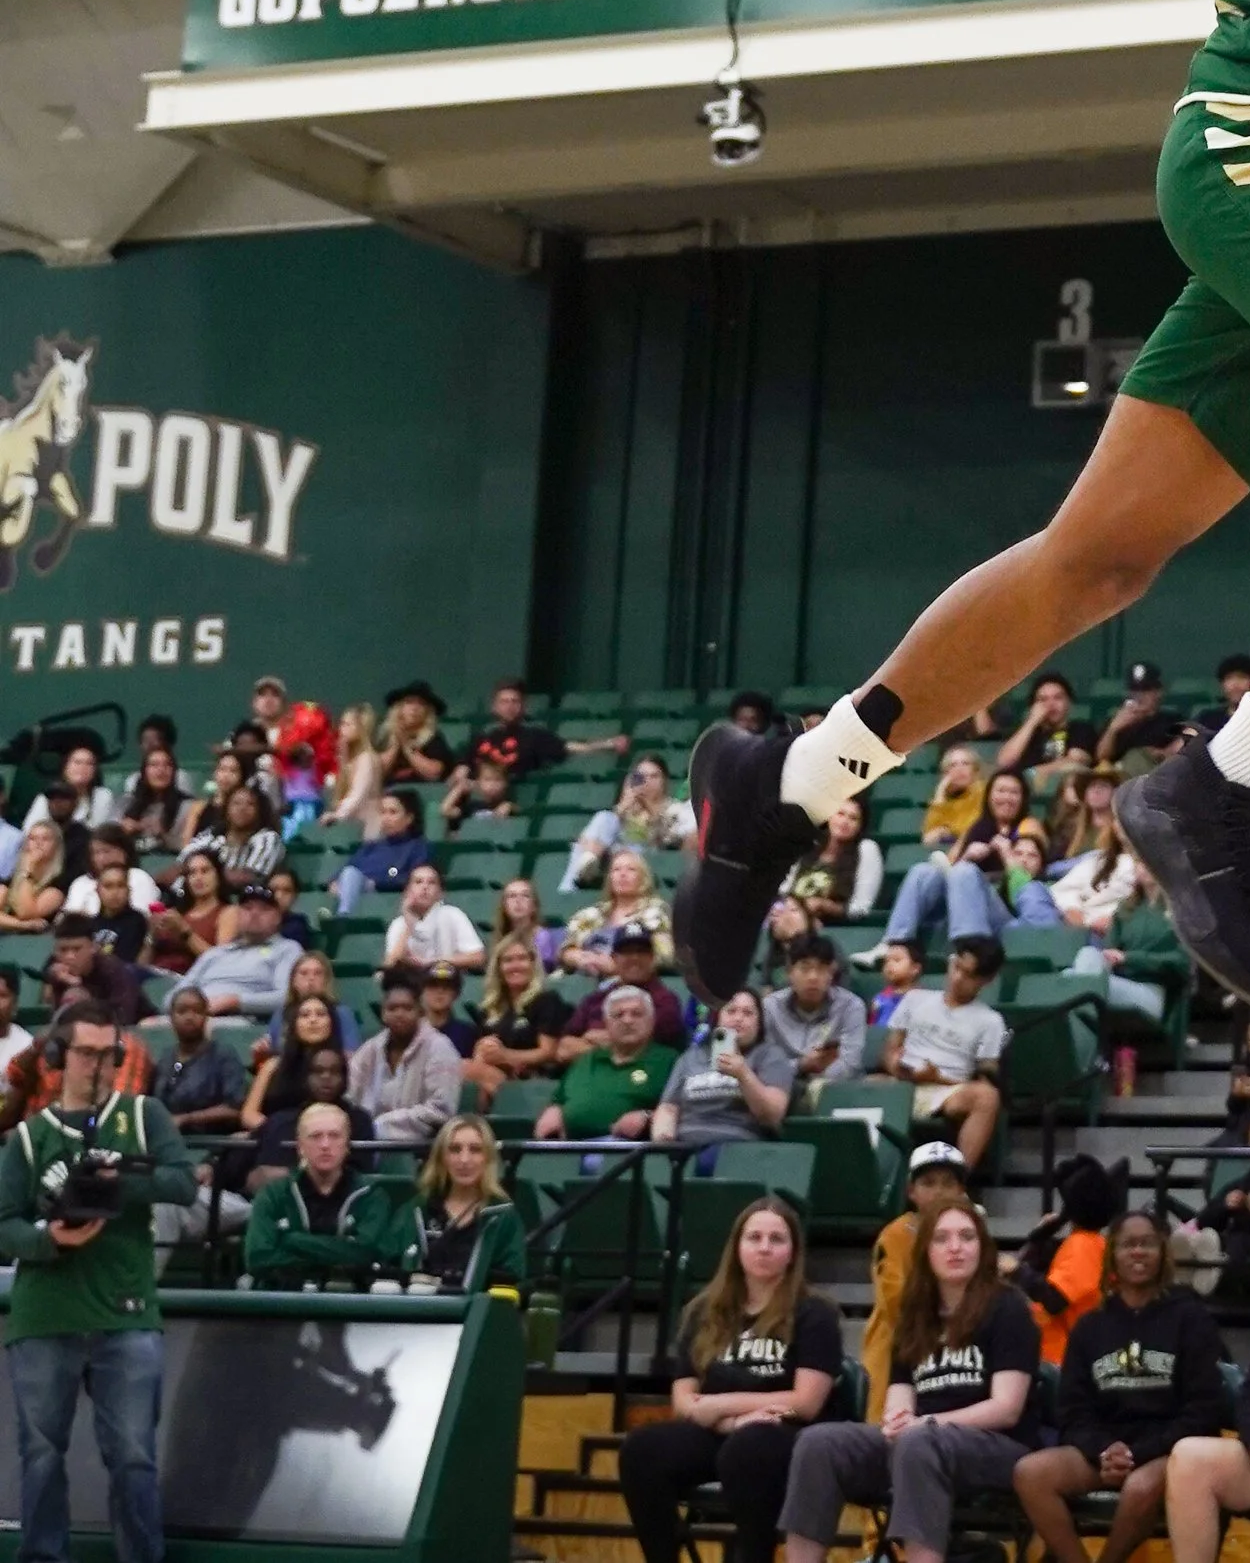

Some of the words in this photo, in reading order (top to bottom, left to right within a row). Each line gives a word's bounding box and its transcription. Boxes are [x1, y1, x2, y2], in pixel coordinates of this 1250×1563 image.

[1058, 277, 1093, 345] 3
[86, 408, 318, 559] POLY
[10, 617, 226, 672] TANGS
